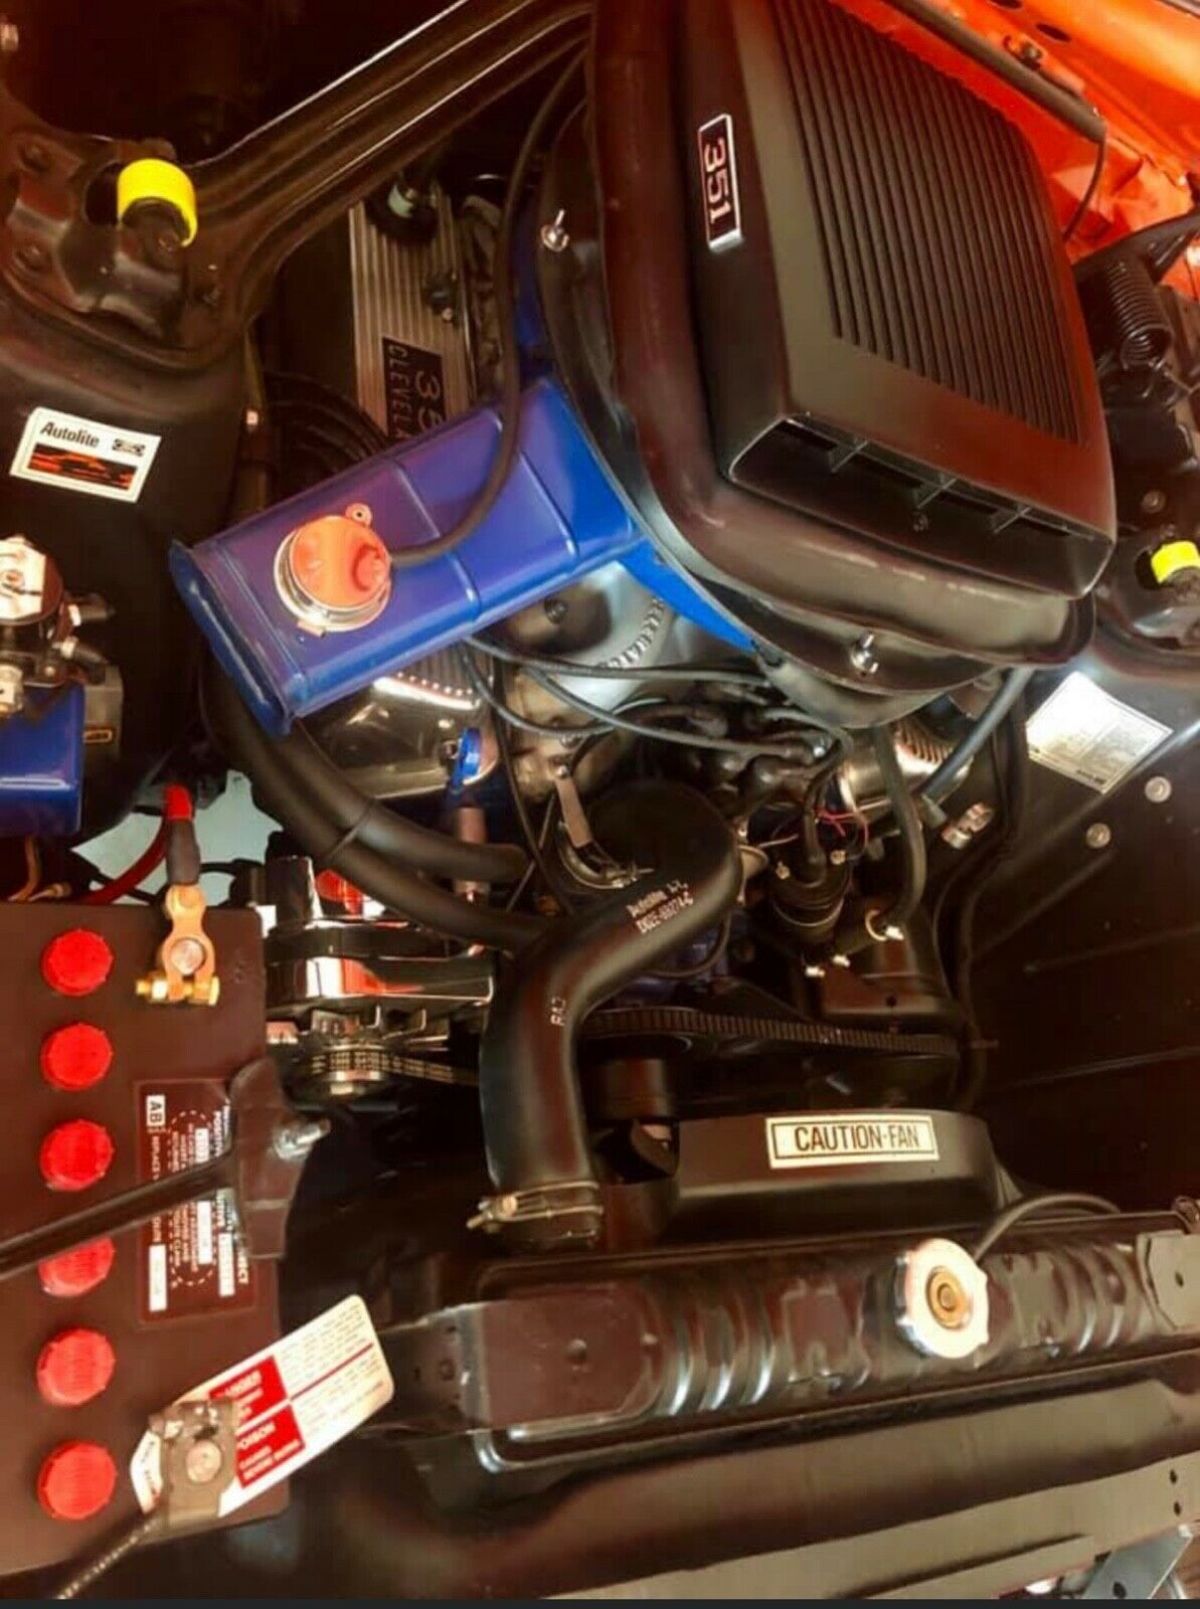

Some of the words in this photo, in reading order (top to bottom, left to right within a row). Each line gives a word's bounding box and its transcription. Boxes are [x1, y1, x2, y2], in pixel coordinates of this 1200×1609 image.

[704, 137, 732, 224] 351
[415, 370, 445, 434] 35
[40, 421, 100, 448] Autolite
[149, 1100, 163, 1123] AB
[213, 1110, 223, 1157] POSITIV
